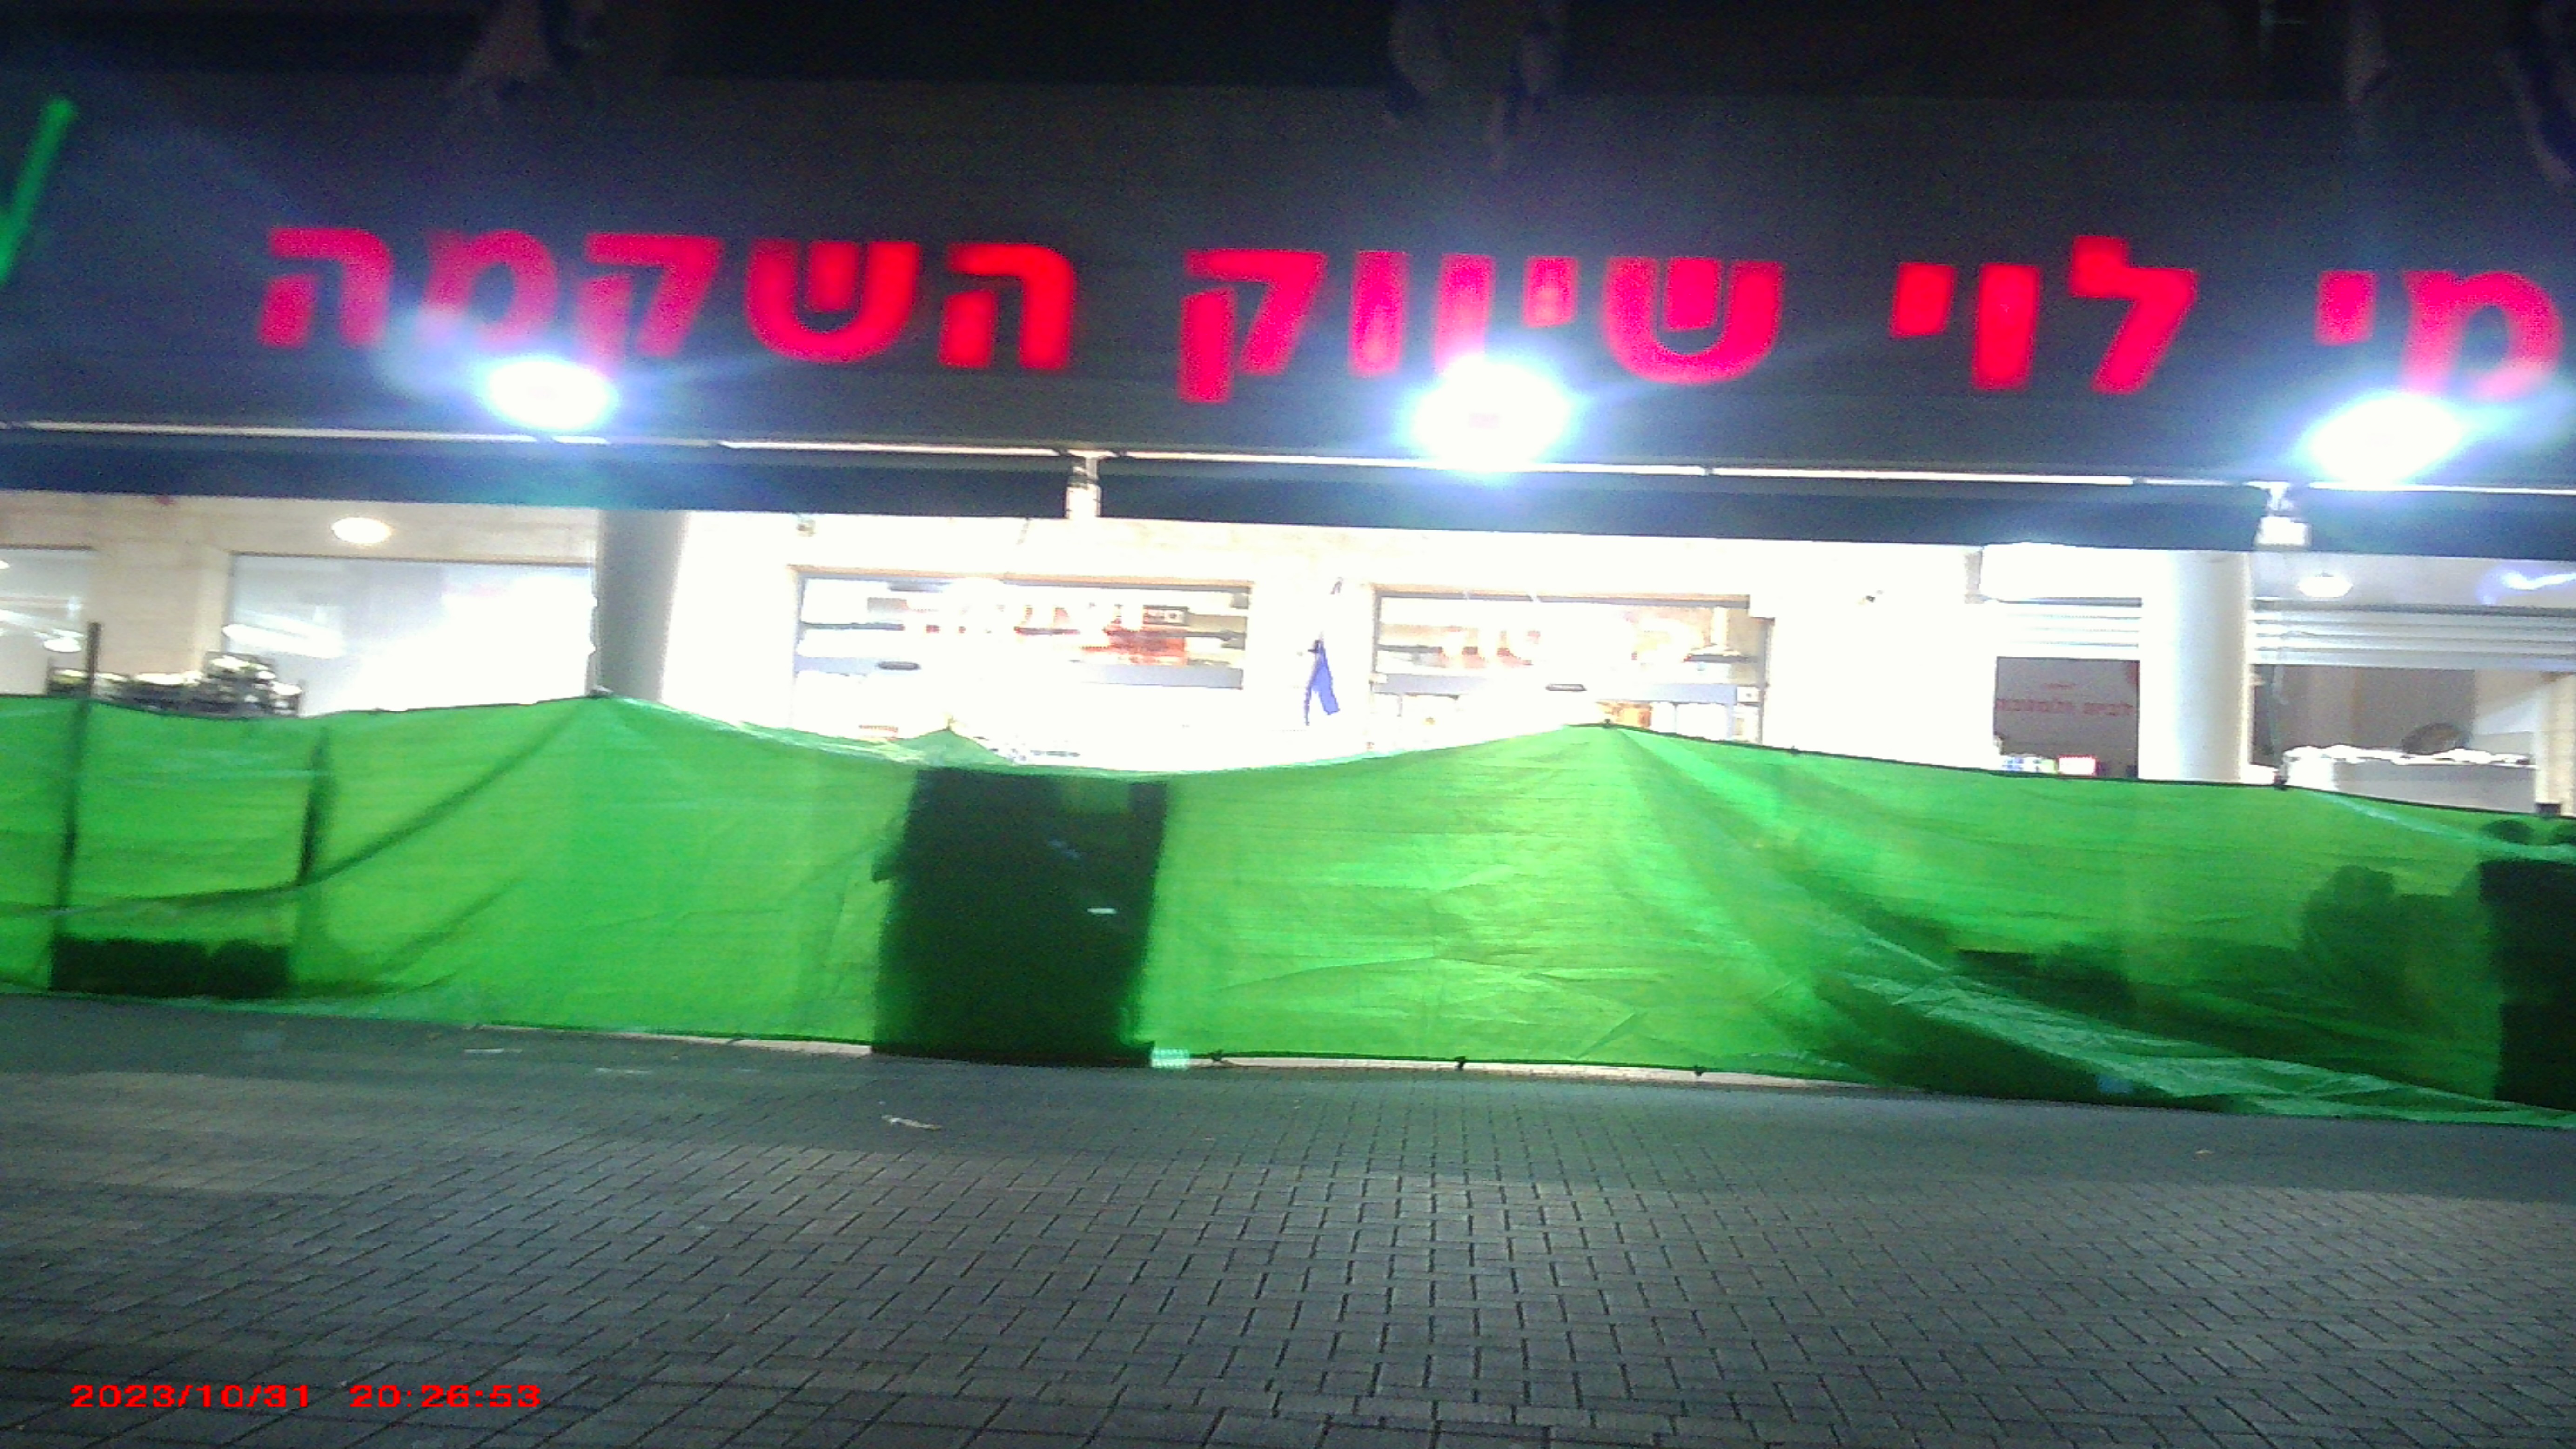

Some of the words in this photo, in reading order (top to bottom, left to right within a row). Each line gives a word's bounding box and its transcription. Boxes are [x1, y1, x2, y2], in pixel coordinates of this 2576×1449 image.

[258, 227, 1079, 371] השקמה
[1176, 246, 1787, 404] שיווק
[1887, 234, 2200, 395] לוי
